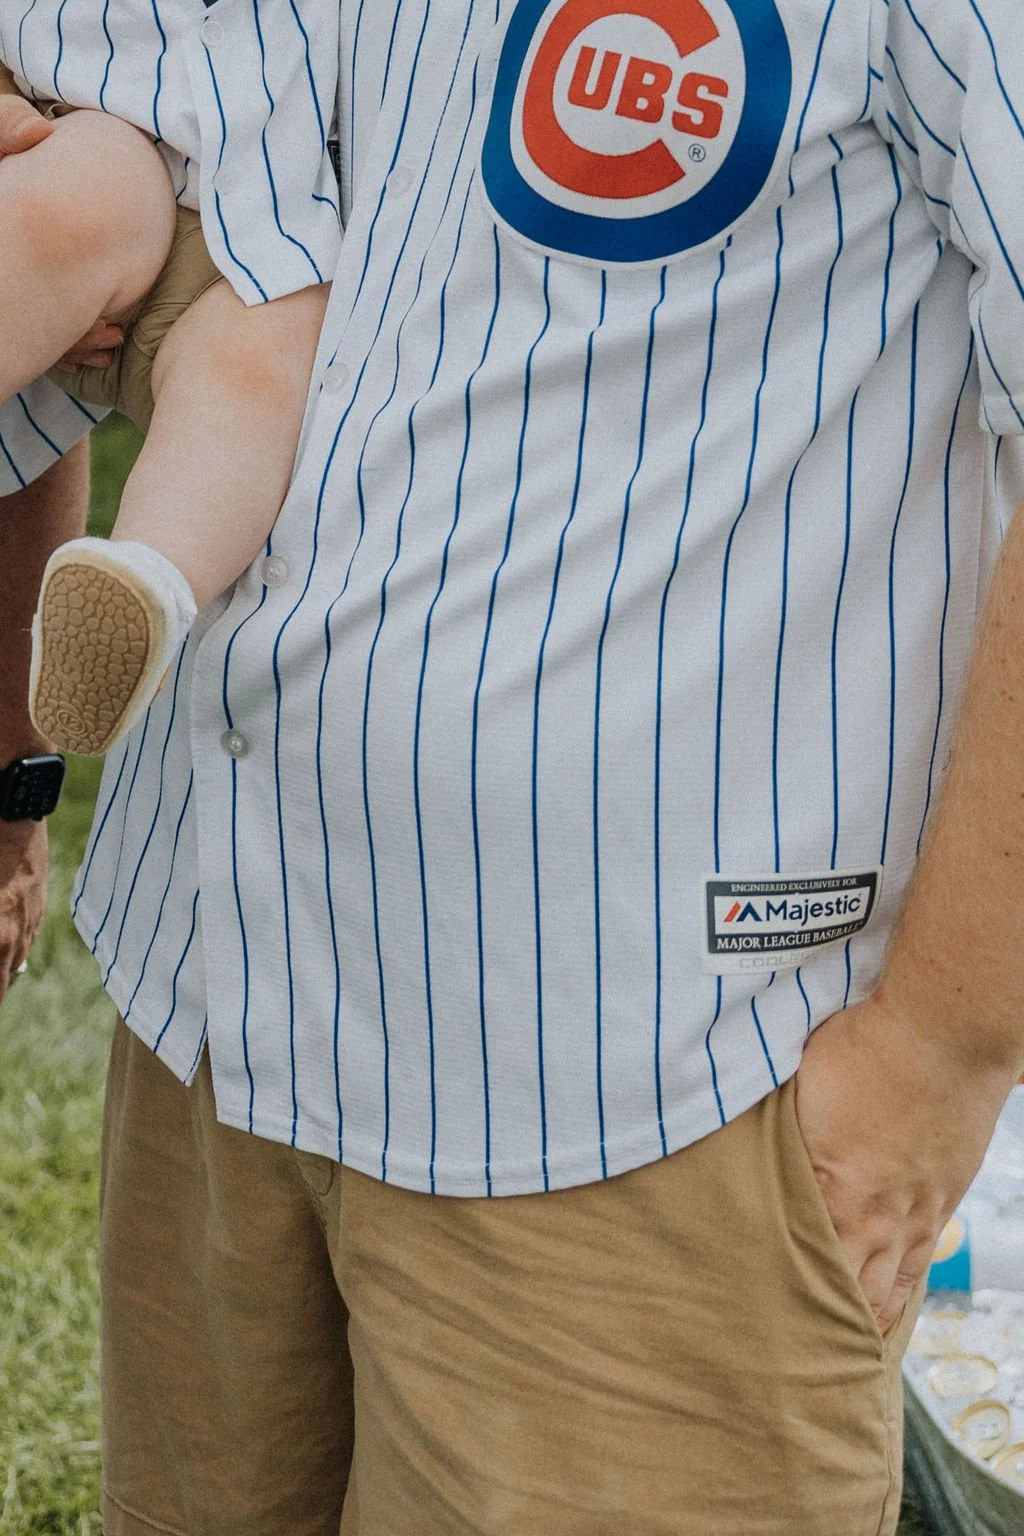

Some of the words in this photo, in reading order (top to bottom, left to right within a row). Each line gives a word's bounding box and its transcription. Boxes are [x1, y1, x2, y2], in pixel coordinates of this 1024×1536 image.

[731, 883, 787, 893] ENGINEERED
[788, 879, 841, 891] EXCLUSIVELY
[842, 877, 857, 887] FOR
[765, 895, 861, 927] Majestic
[717, 936, 762, 951] MAJOR
[764, 932, 811, 948] LEAGUE
[812, 922, 859, 942] BASEBALL
